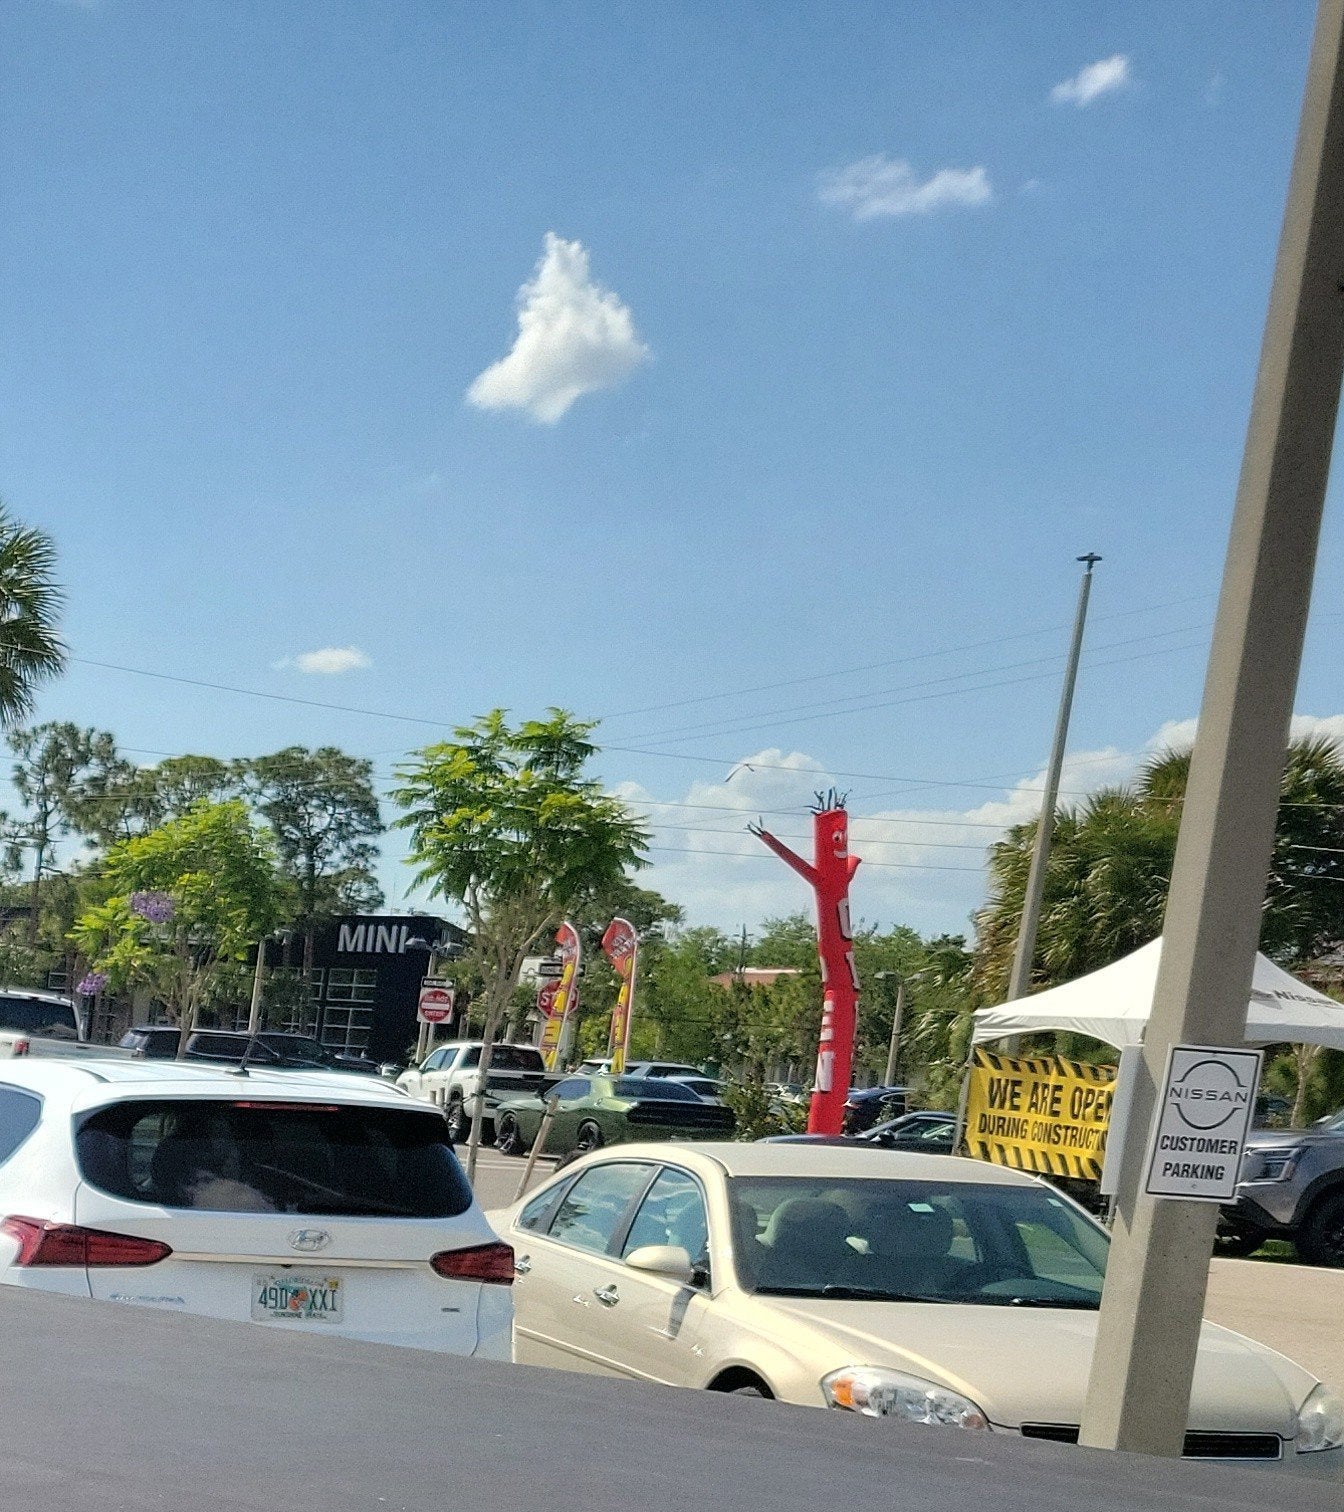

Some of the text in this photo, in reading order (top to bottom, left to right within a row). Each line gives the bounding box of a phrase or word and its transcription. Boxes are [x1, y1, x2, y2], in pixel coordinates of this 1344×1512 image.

[337, 924, 408, 953] MINI
[988, 1076, 1023, 1112] WE
[1027, 1081, 1064, 1118] ARE
[1170, 1087, 1248, 1103] NISSAN
[977, 1112, 1028, 1140] DURING
[1160, 1134, 1239, 1155] CUSTOMER
[1162, 1162, 1226, 1180] PARKING
